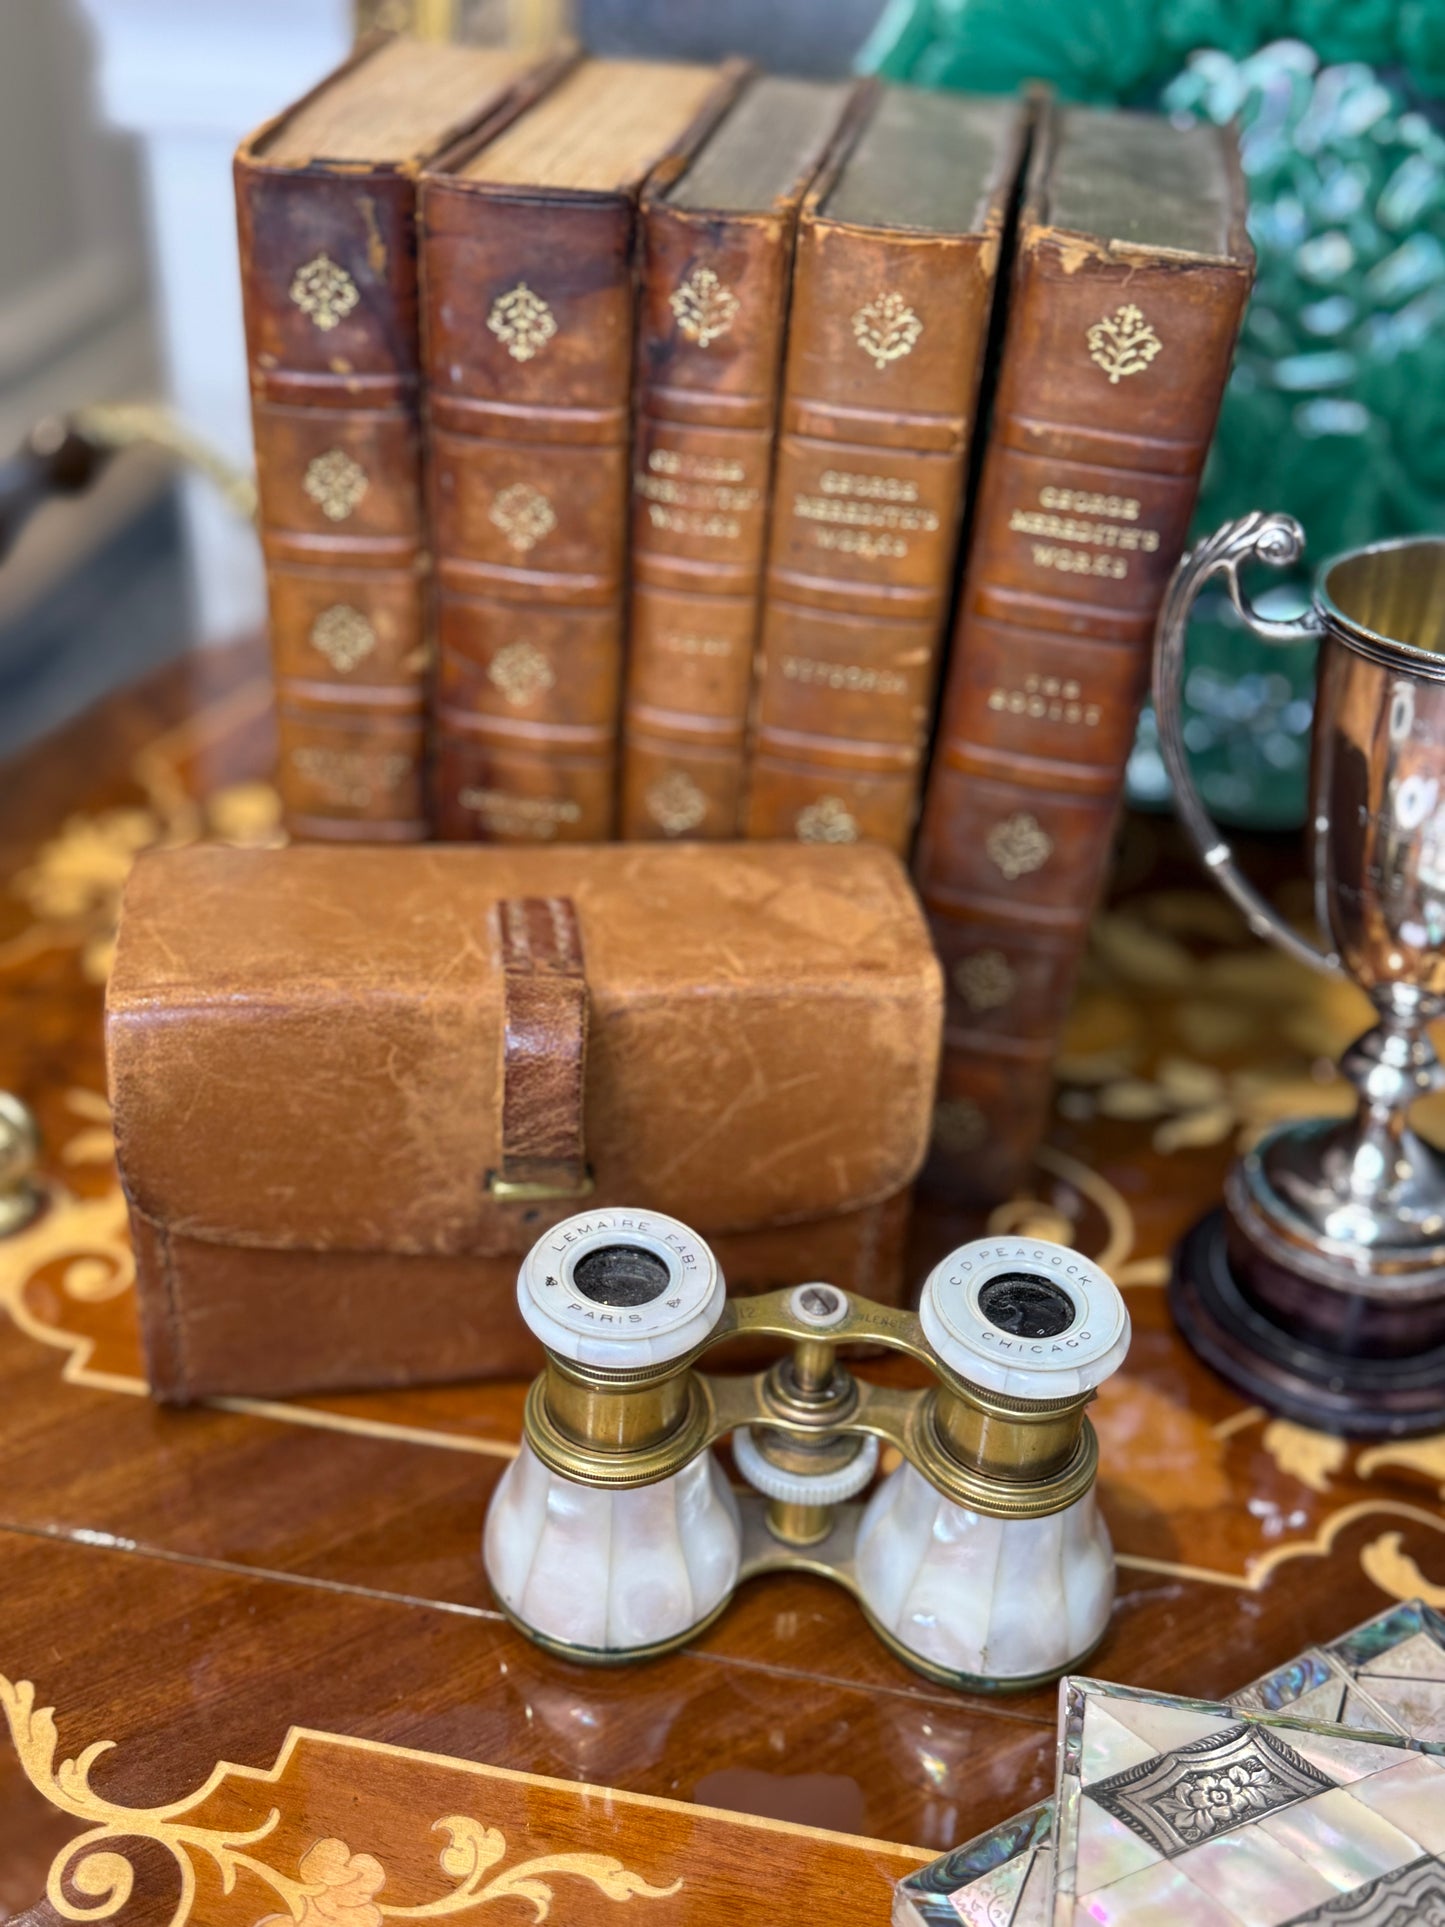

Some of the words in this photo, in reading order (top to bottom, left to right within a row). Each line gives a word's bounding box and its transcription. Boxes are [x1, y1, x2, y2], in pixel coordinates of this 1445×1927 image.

[1039, 486, 1140, 520] GEORGE
[1009, 508, 1159, 552] MEREDITH'S
[1031, 543, 1127, 579] WORKS
[552, 1219, 649, 1252] LEMAIRE
[979, 1247, 1092, 1287] PEACOCK
[567, 1302, 642, 1324] PARIS
[981, 1331, 1091, 1354] CHICAGO
